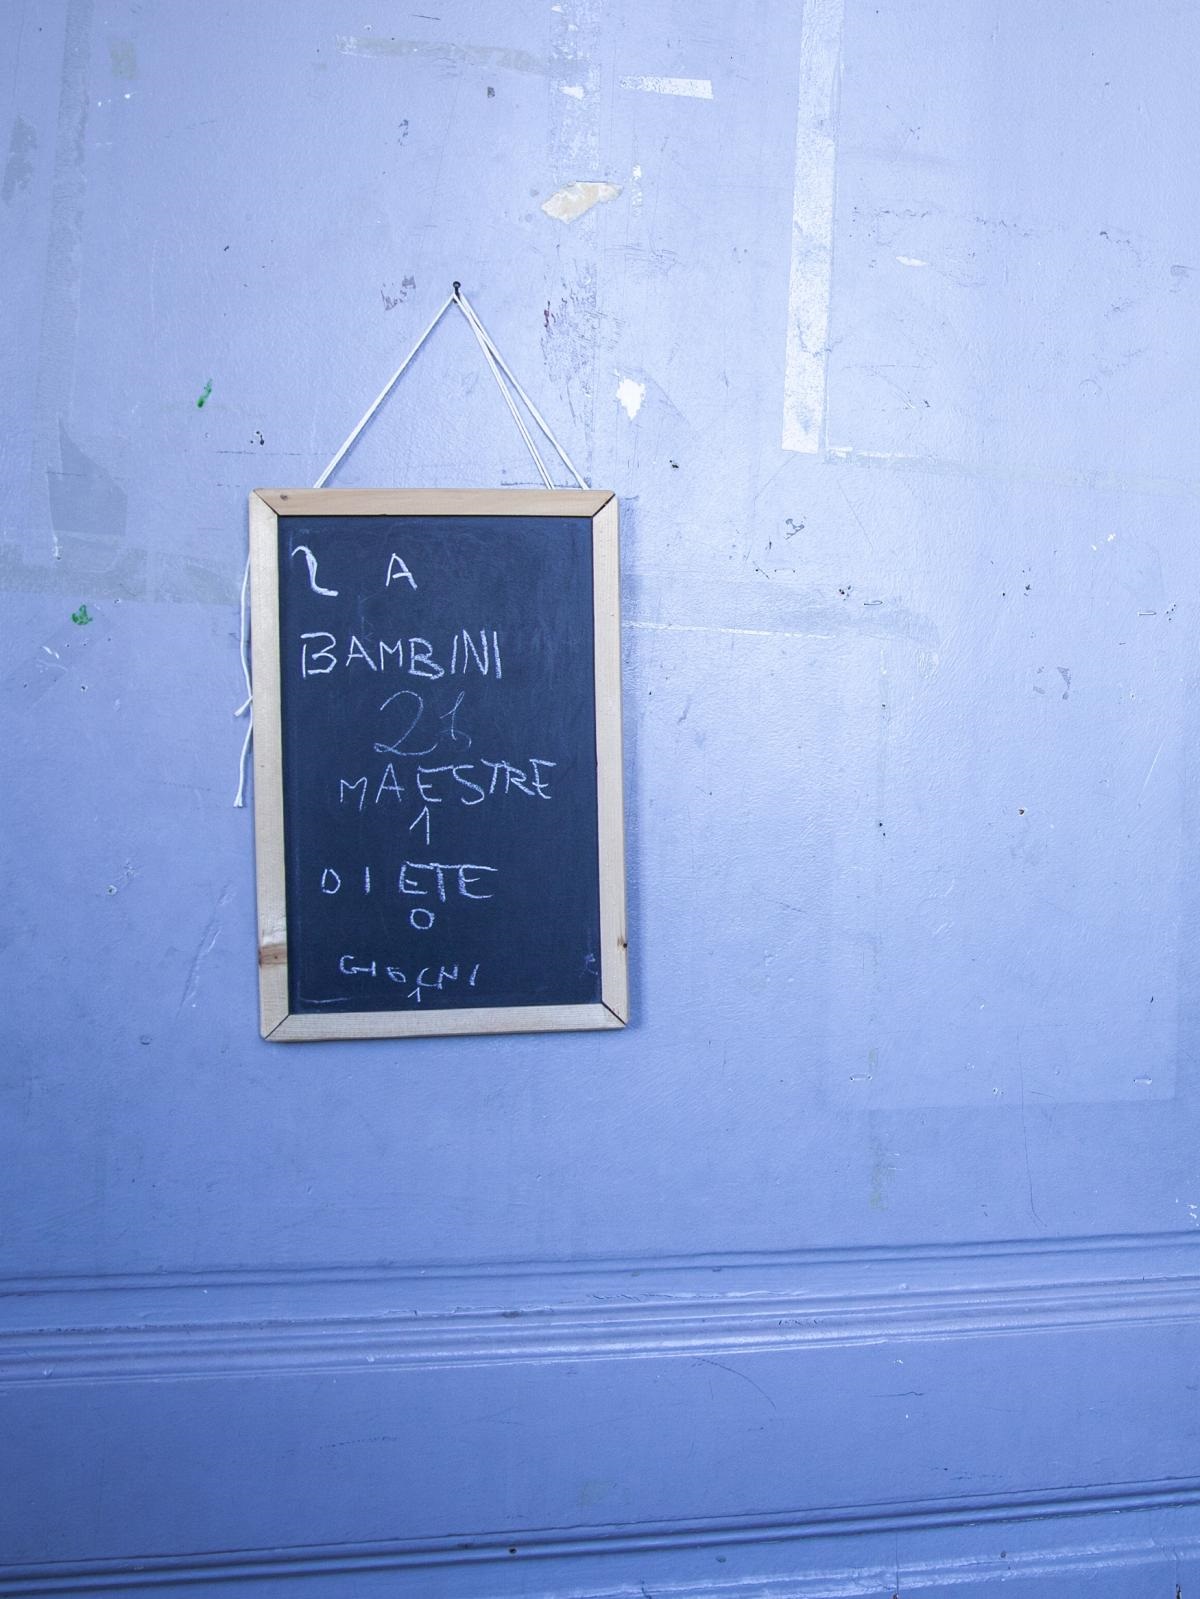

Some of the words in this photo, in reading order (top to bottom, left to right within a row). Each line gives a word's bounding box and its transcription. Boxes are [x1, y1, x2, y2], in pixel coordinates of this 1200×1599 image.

[291, 545, 339, 597] 2
[386, 553, 418, 591] A
[300, 629, 502, 680] BAMBINI
[340, 758, 557, 811] MAESTRE
[409, 805, 431, 845] 1
